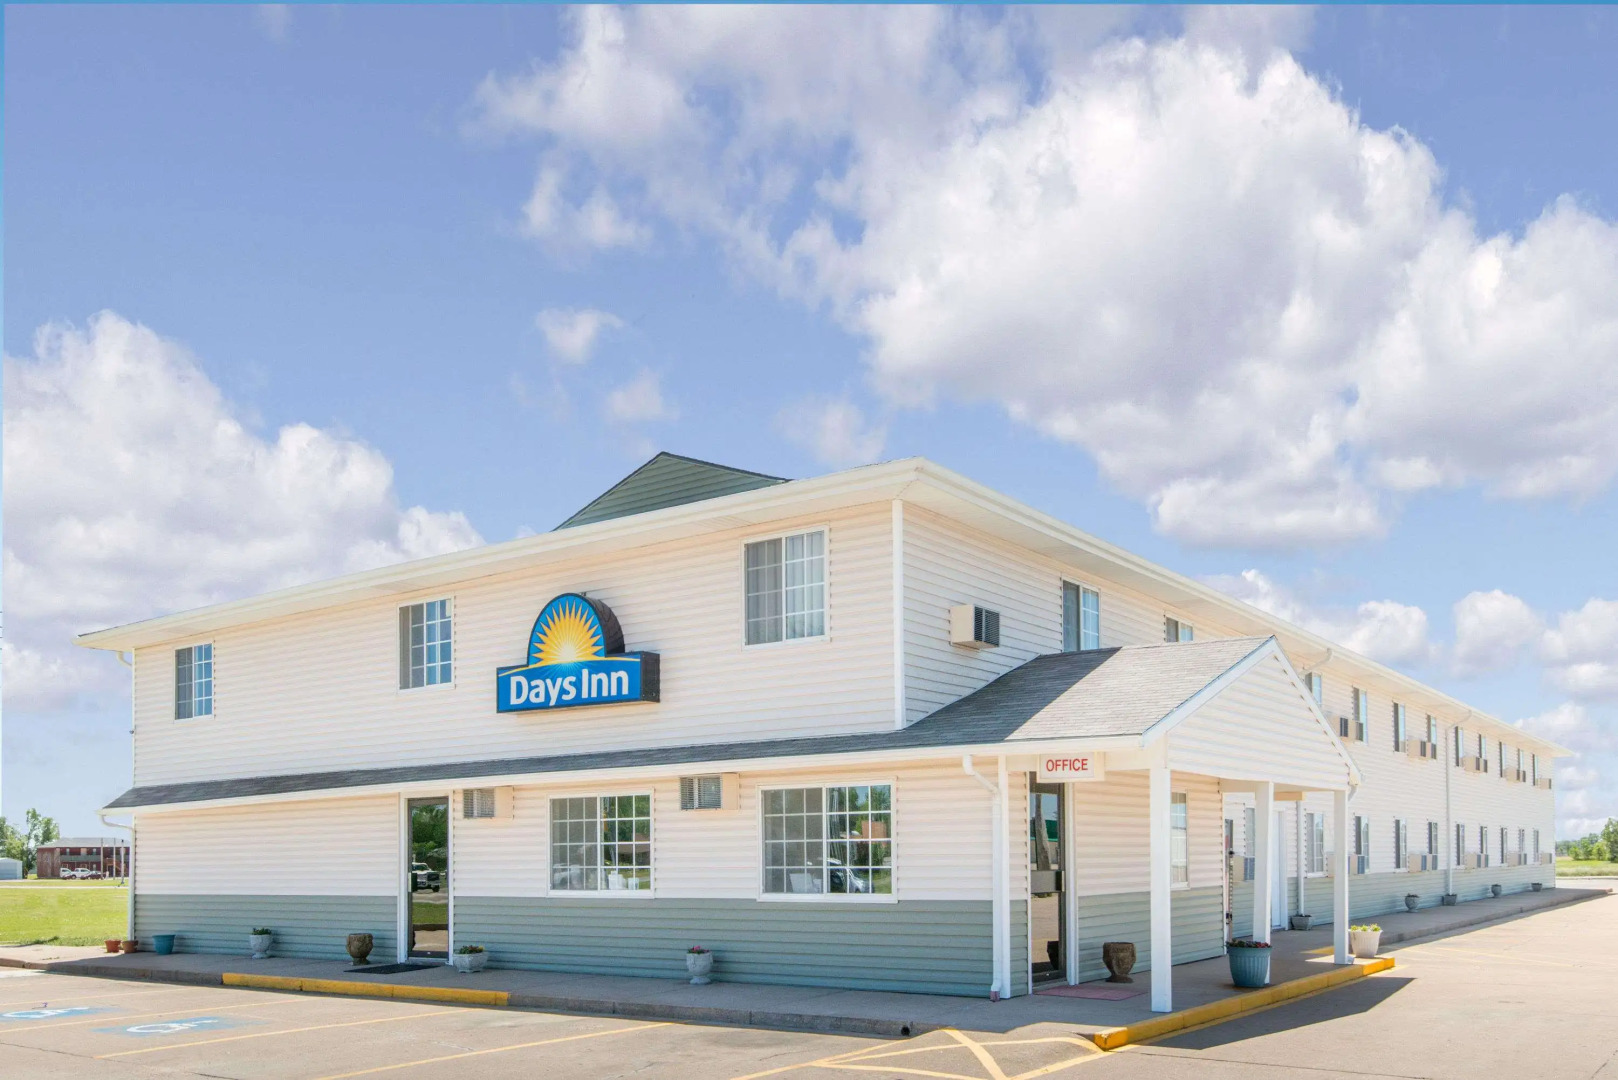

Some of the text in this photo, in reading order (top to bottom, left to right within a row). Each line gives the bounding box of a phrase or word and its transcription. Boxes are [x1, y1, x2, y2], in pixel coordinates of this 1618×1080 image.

[510, 668, 629, 706] Days Inn
[1046, 758, 1089, 772] OFFICE
